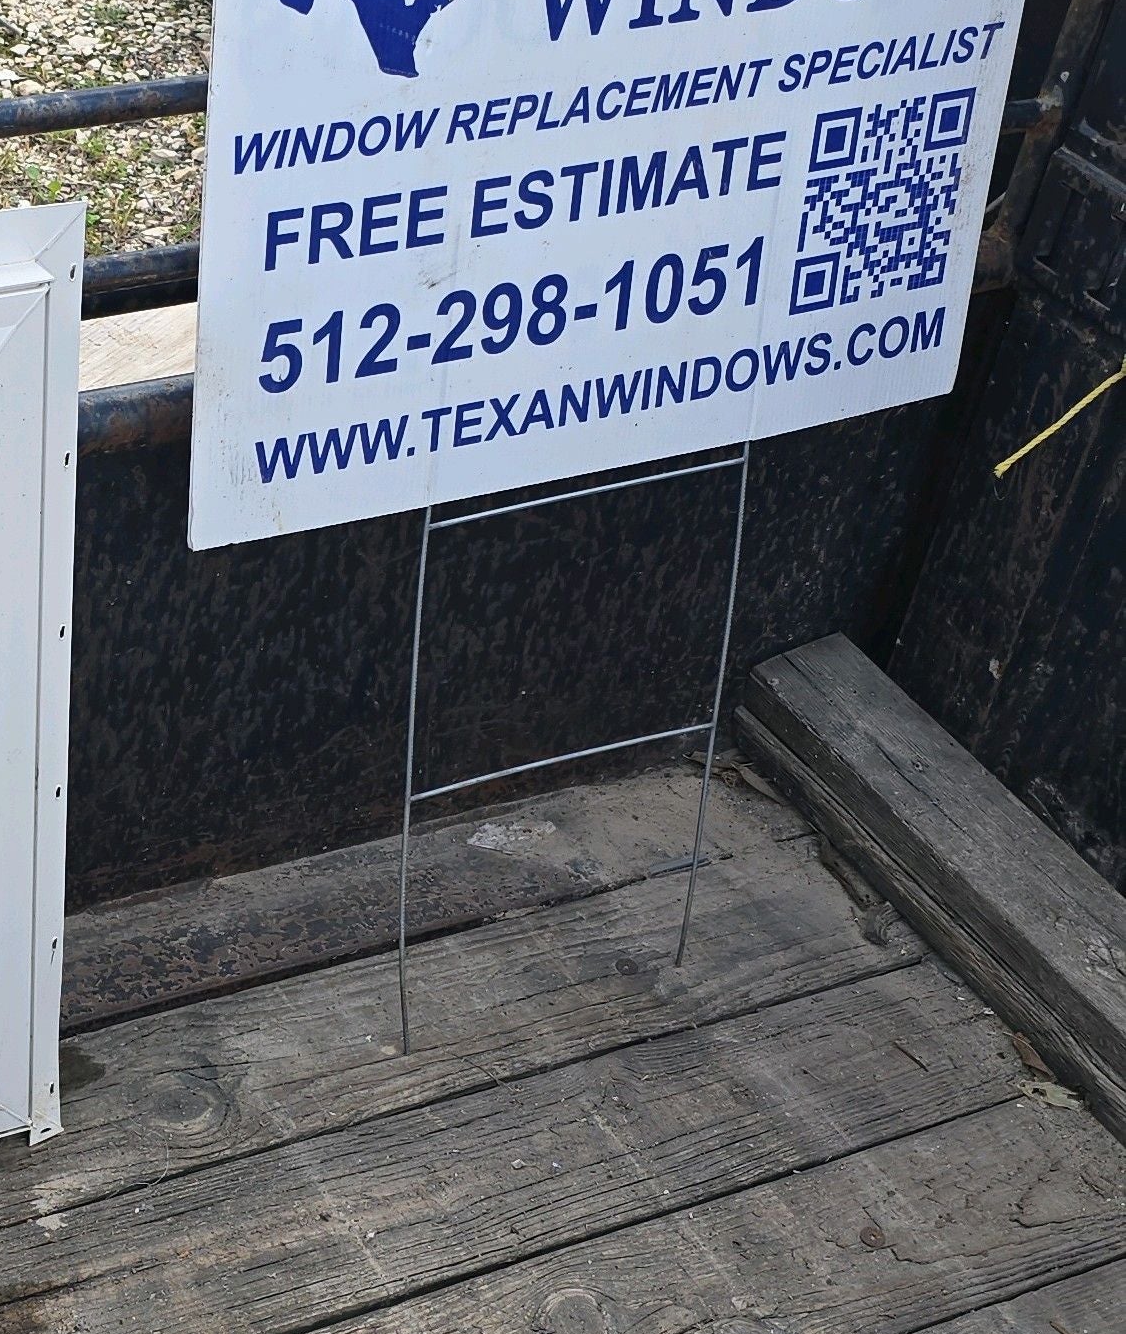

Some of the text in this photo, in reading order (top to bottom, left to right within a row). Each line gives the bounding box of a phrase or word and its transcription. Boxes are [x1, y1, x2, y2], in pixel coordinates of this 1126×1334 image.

[234, 21, 1005, 175] WINDOW REPLACEMENT SPECIALIST
[265, 131, 787, 271] FREE ESTIMATE
[259, 236, 764, 393] 512-298-1051
[255, 307, 946, 483] WWW.TEXANWINDOWS.COM
